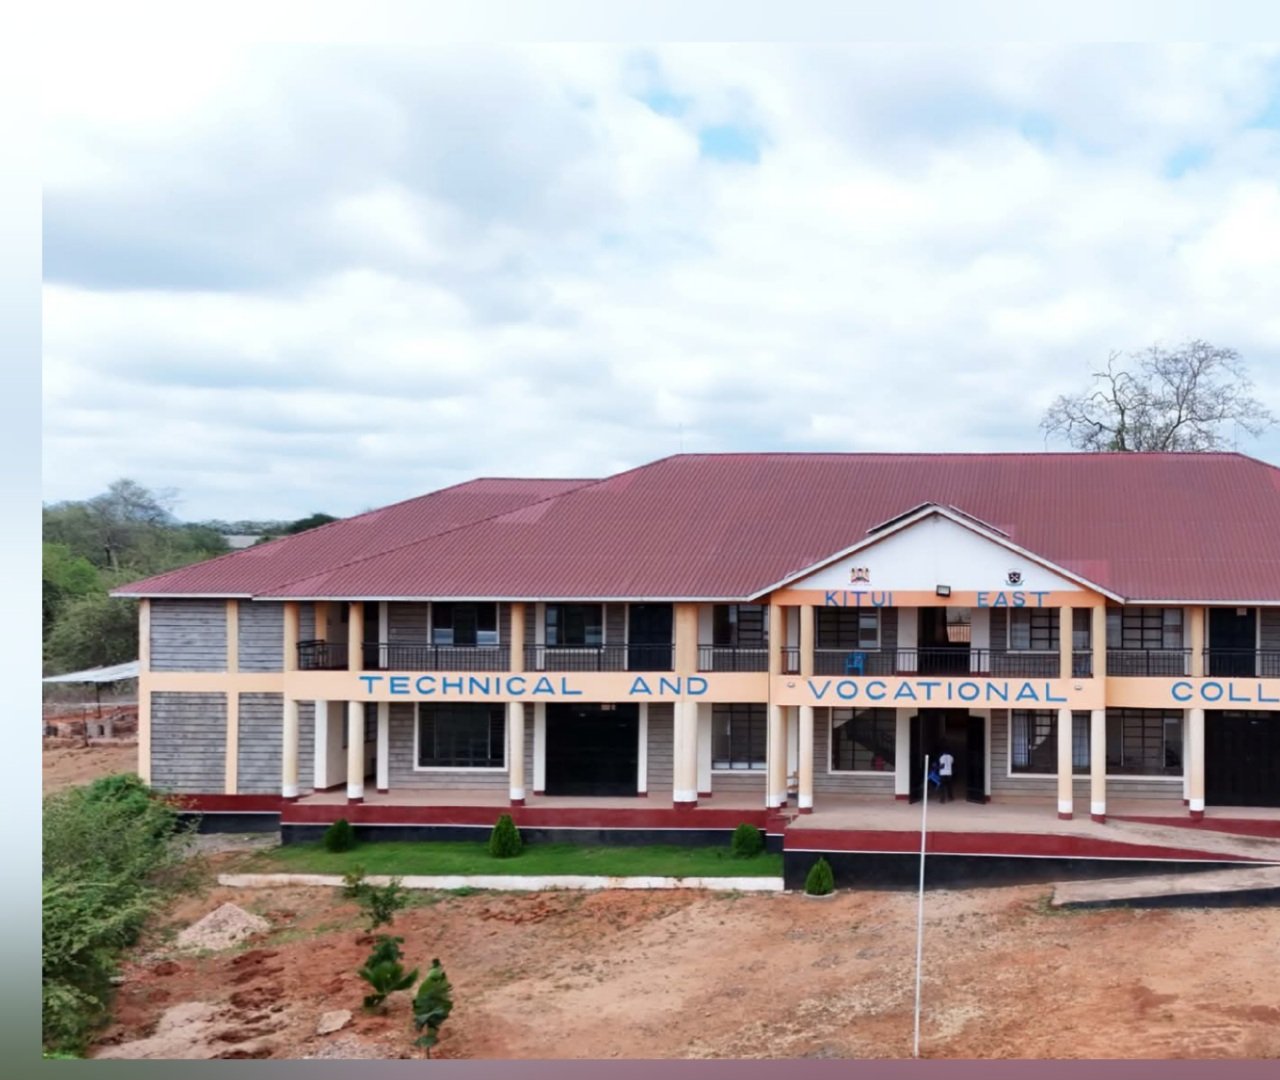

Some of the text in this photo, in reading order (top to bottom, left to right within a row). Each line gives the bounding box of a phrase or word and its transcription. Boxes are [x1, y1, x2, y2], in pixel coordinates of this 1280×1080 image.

[825, 591, 1051, 608] KITUI EAST
[358, 674, 583, 697] TECHNICAL
[629, 675, 709, 696] AND
[808, 679, 1067, 703] VOCATIONAL
